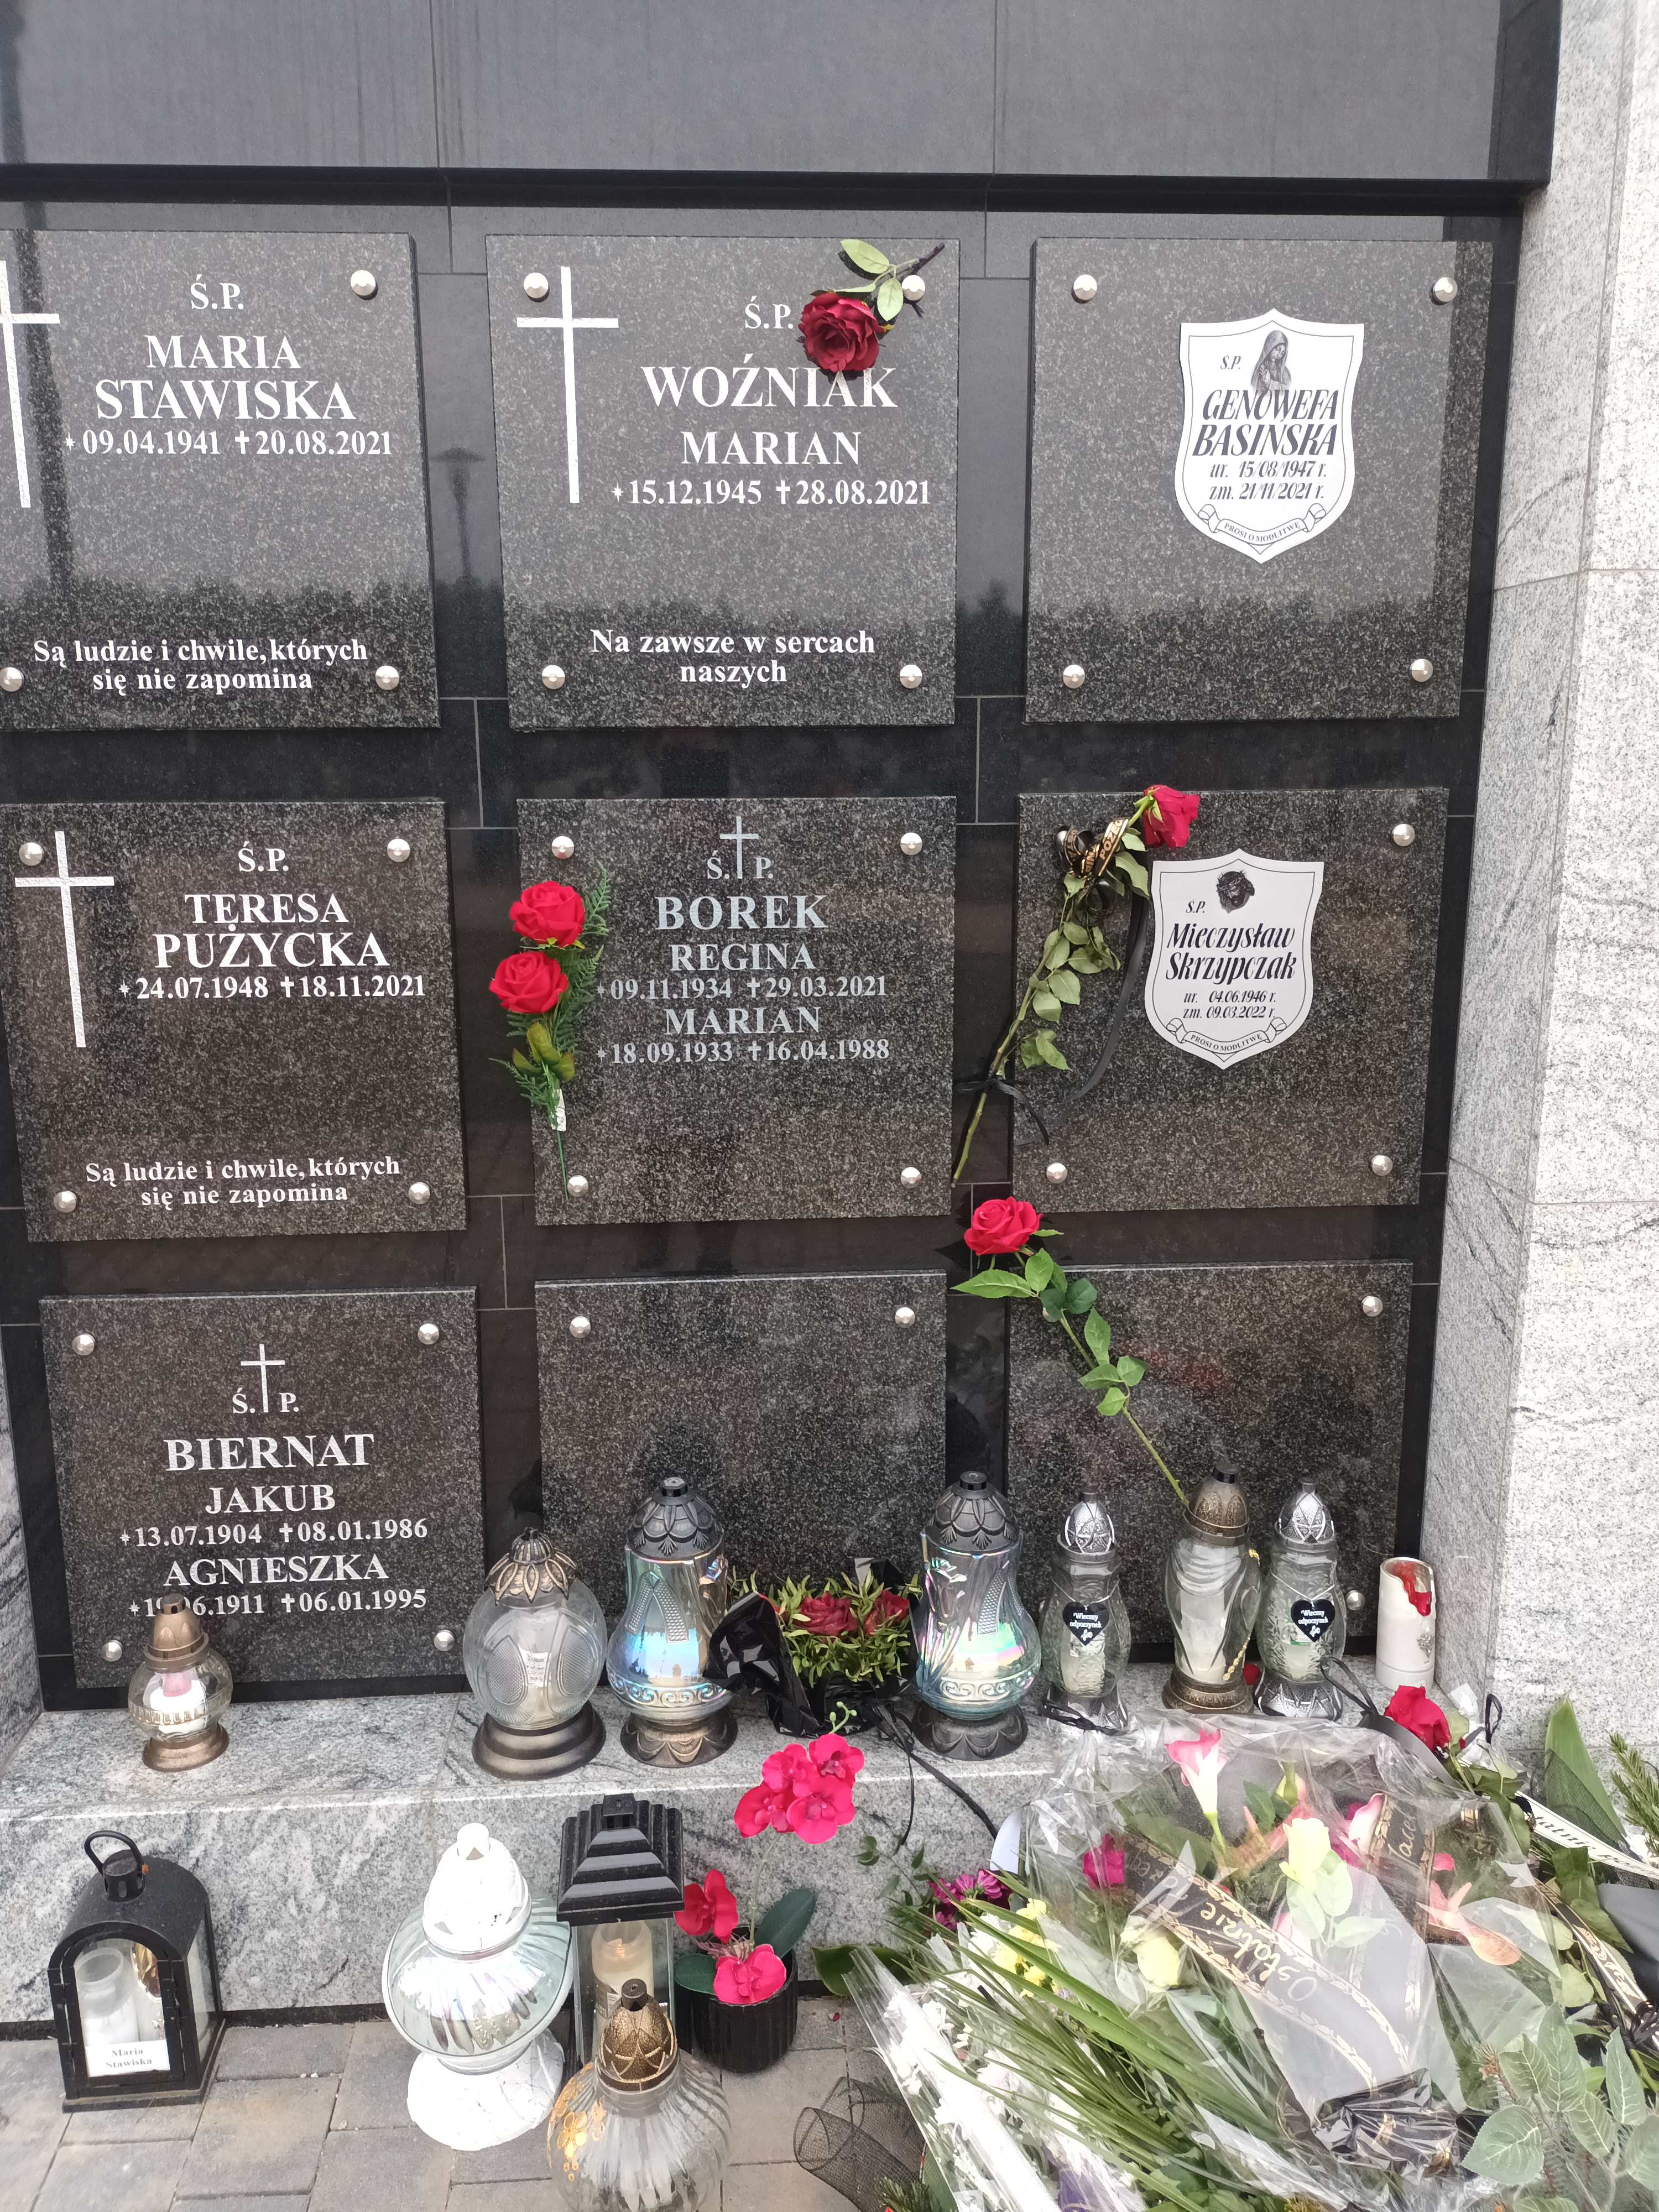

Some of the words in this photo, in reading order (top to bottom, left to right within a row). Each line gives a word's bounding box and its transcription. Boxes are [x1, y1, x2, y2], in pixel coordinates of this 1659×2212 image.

[190, 274, 244, 310] Ś.P.
[744, 295, 795, 330] Ś.P.
[145, 335, 301, 369] MARIA
[640, 353, 898, 408] WOŹNIAK
[96, 379, 356, 420] STAWISKA
[1202, 389, 1339, 420] GENOWEFA
[83, 430, 220, 455] 09.04.1941
[255, 430, 391, 455] 20.08.2021
[681, 431, 861, 465] MARIAN
[1192, 420, 1337, 456] BASIŃSKA
[1210, 463, 1228, 478] ur.
[1239, 461, 1316, 478] 15/08/1947
[1318, 463, 1326, 477] r.
[630, 479, 761, 504] 15.12.1945
[796, 479, 928, 504] 28.08.2021
[1209, 485, 1233, 500] zm.
[1239, 482, 1311, 500] 21/11/2021
[1316, 484, 1324, 499] r.
[1224, 523, 1247, 538] PROSI
[34, 640, 66, 668] Są
[74, 640, 152, 661] ludzie
[162, 640, 169, 661] i
[591, 629, 629, 653] Na
[640, 636, 734, 653] zawsze
[743, 637, 766, 653] w
[775, 630, 875, 653] sercach
[92, 669, 127, 696] się
[138, 669, 176, 690] nie
[186, 667, 313, 694] zapomina
[680, 659, 787, 688] naszych
[238, 841, 289, 873] Ś.P.
[707, 851, 730, 880] Ś.
[755, 856, 771, 879] P.
[184, 893, 349, 924] TERESA
[655, 895, 828, 930] BOREK
[153, 924, 390, 968] PUŻYCKA
[1167, 923, 1295, 952] Mieczysław
[669, 943, 816, 971] REGINA
[1166, 952, 1297, 985] Skrzypczak
[136, 976, 268, 999] 24.07.1948
[300, 975, 425, 997] 18.11.2021
[611, 978, 732, 999] 09.11.1934
[765, 975, 886, 998] 29.03.2021
[1183, 992, 1198, 1003] ur.
[1209, 990, 1267, 1003] 04.06.1946
[1269, 992, 1276, 1002] r.
[664, 1006, 821, 1035] MARIAN
[1183, 1008, 1202, 1019] zm.
[1206, 1006, 1266, 1018] 09.03.2022
[1269, 1008, 1275, 1018] r.
[613, 1041, 732, 1063] 18.09.1933
[767, 1039, 889, 1062] 16.04.1988
[1191, 1035, 1212, 1048] PROSI
[86, 1163, 117, 1187] Są
[124, 1161, 197, 1181] ludzie
[206, 1160, 213, 1179] i
[140, 1185, 174, 1211] się
[184, 1185, 220, 1205] nie
[229, 1183, 348, 1207] zapomina
[232, 1387, 256, 1414] Ś.
[279, 1392, 300, 1413] P.
[163, 1434, 374, 1471] BIERNAT
[205, 1484, 335, 1514] JAKUB
[135, 1524, 262, 1547] 13.07.1904
[298, 1518, 427, 1542] 08.01.1986
[163, 1554, 389, 1586] AGNIESZKA
[144, 1594, 264, 1617] 16.1911
[300, 1589, 426, 1612] 06.01.1995
[106, 2058, 152, 2068] Stawiska
